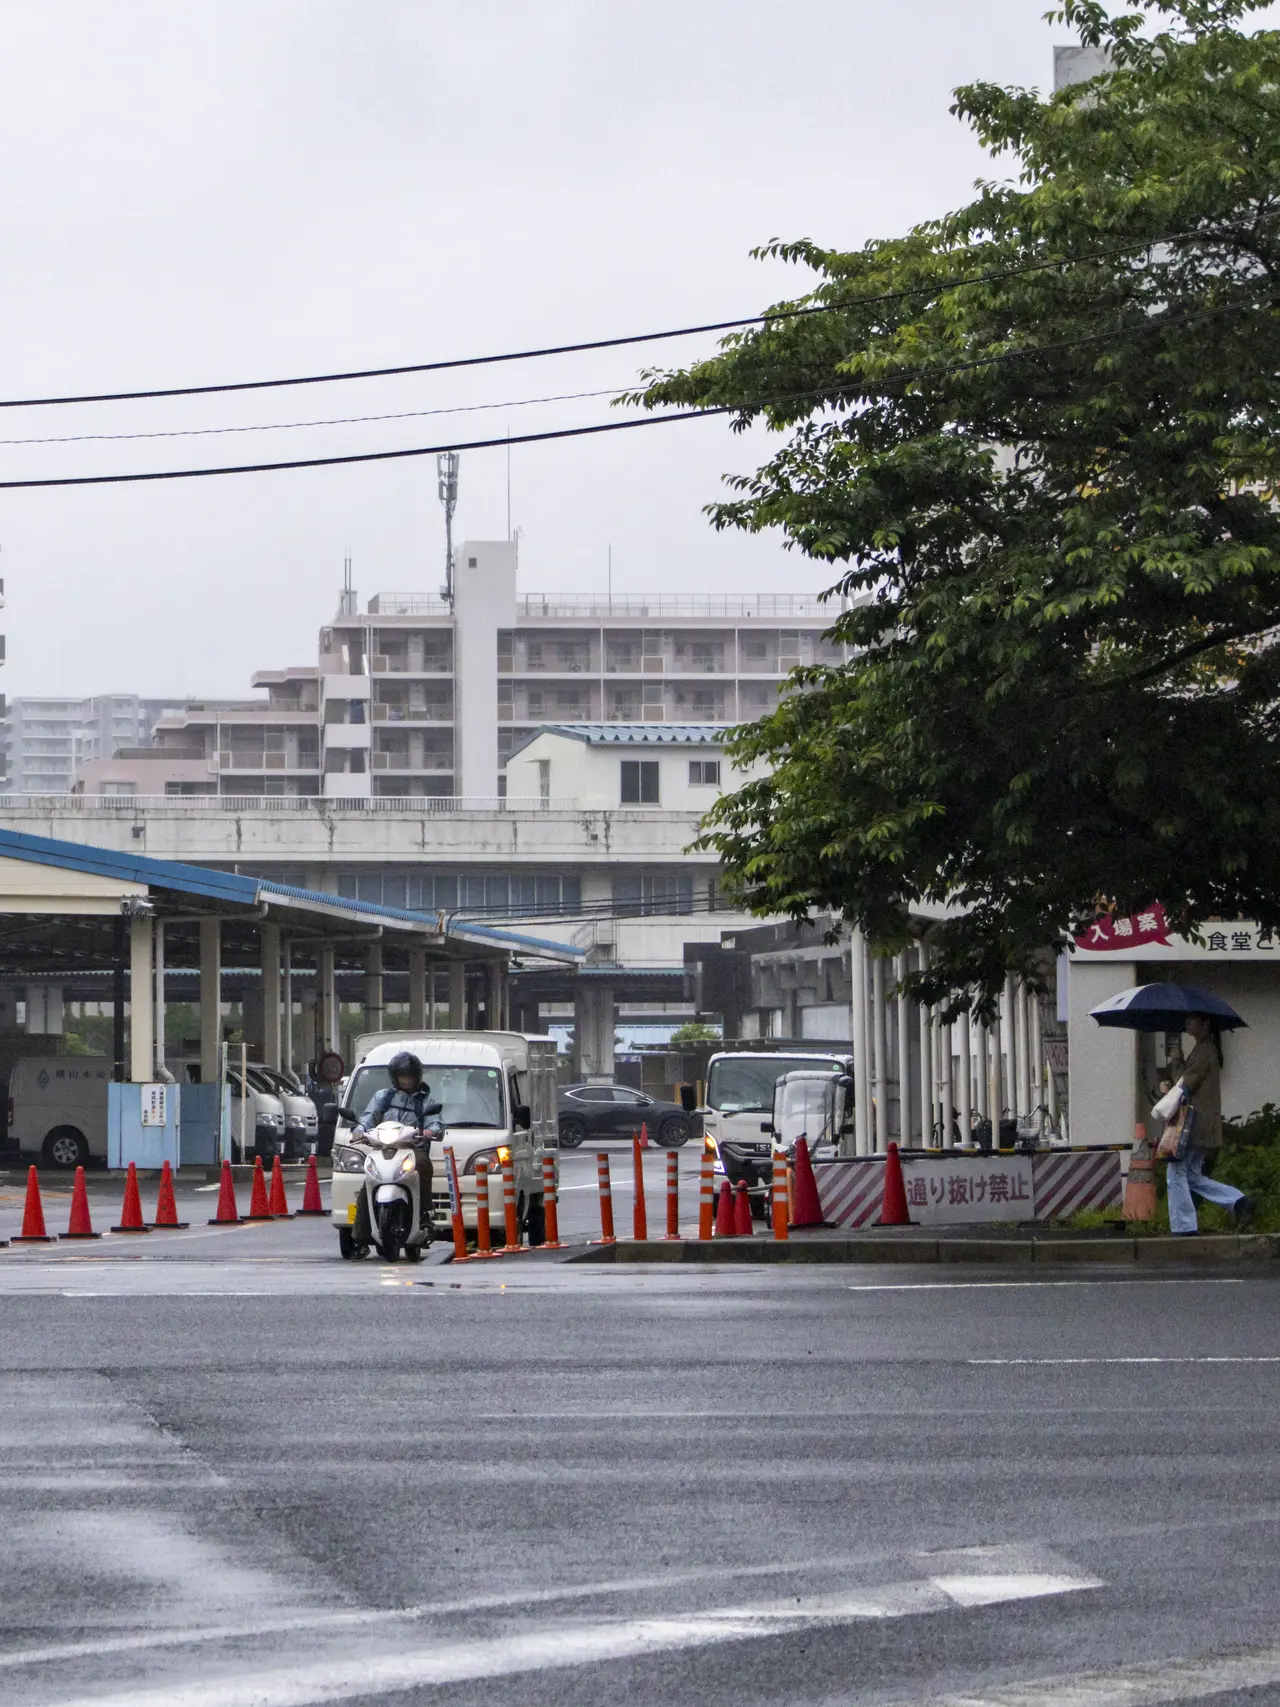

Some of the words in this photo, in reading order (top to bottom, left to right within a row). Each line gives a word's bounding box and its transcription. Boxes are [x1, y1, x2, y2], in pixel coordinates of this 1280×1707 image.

[1090, 912, 1170, 944] 入場案
[908, 1172, 1030, 1206] 通り抜け禁止
